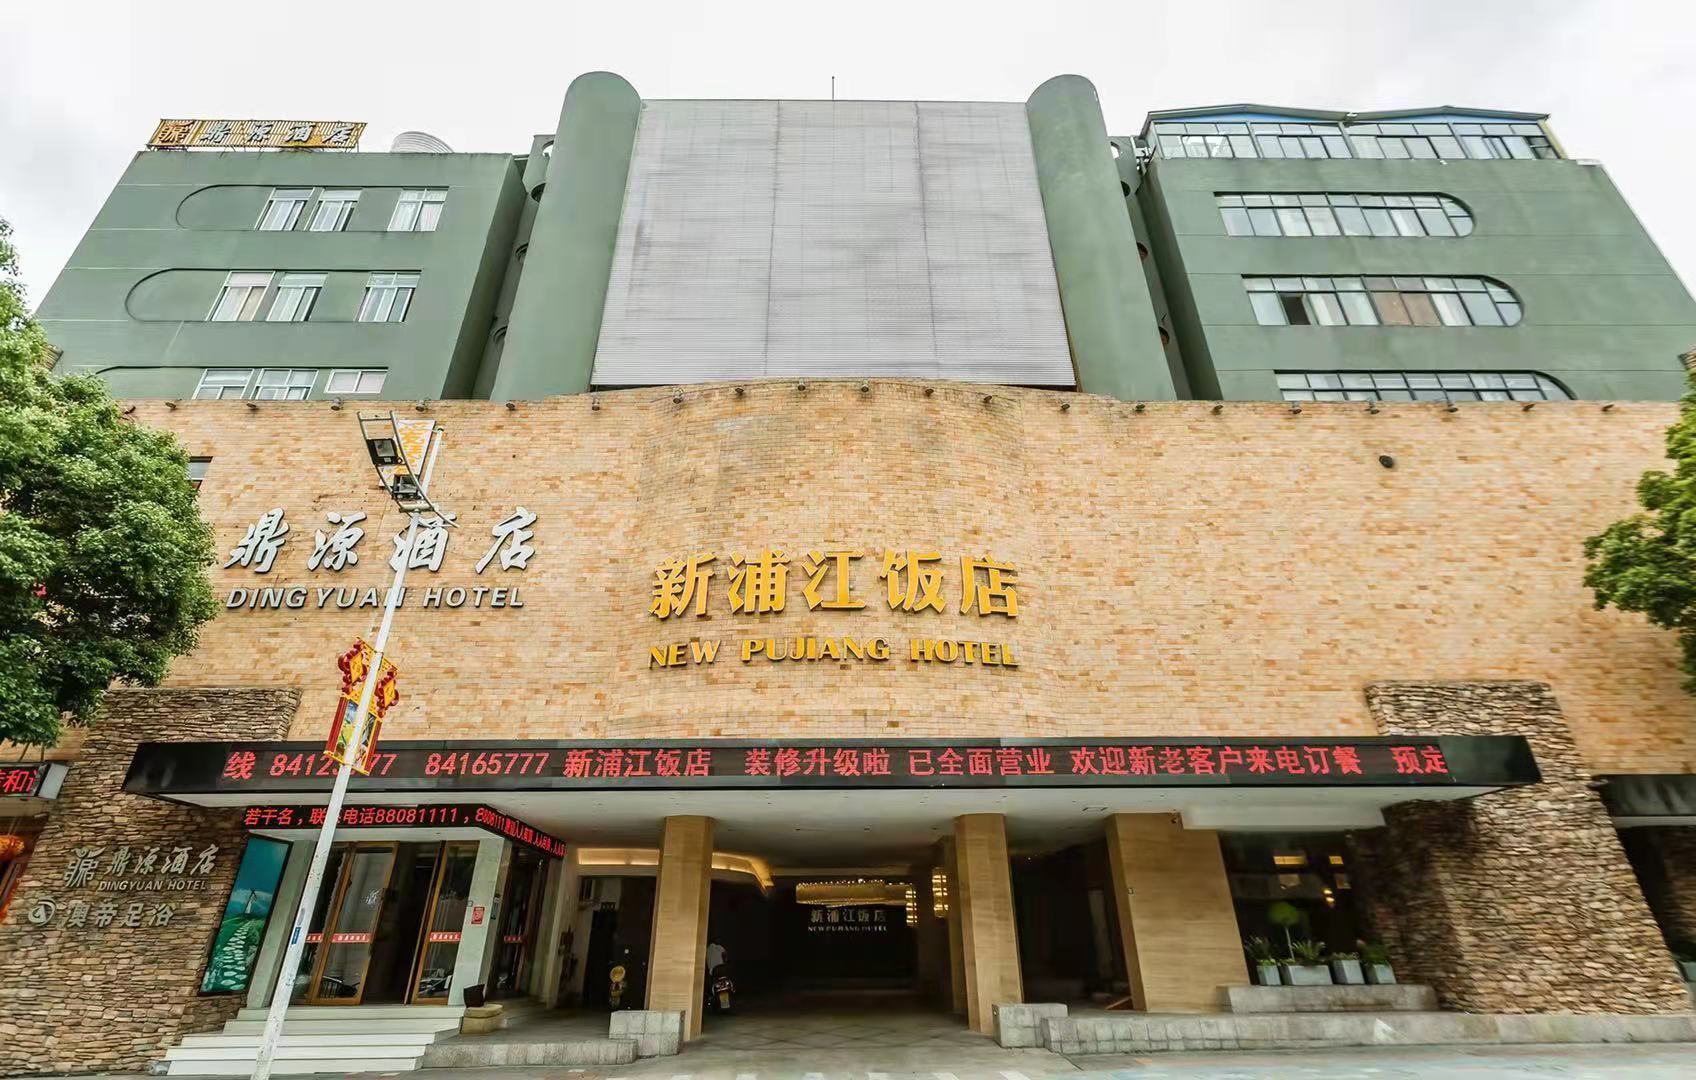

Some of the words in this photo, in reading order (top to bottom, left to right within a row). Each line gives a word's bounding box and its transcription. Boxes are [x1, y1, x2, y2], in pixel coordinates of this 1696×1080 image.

[201, 121, 355, 144] 鼎源酒店
[224, 506, 538, 573] 鼎源酒店
[226, 587, 406, 609] DINGYUAN
[423, 587, 524, 608] HOTEL
[648, 549, 1020, 619] 新浦江饭店
[648, 639, 721, 669] NEW
[741, 636, 890, 662] PUJIANG
[911, 637, 1020, 667] HOTEL
[224, 752, 256, 780] 线
[424, 752, 549, 776] 84165777
[563, 749, 711, 777] 新浦江饭店
[745, 748, 892, 776] 装修升级啦
[908, 748, 1055, 776] 已全面营业
[1071, 746, 1362, 775] 欢迎新老客户来电订餐
[1392, 746, 1449, 774] 预定
[104, 844, 219, 878] 鼎源酒店
[98, 880, 163, 891] DINGYUAN
[167, 879, 207, 891] HOTEL
